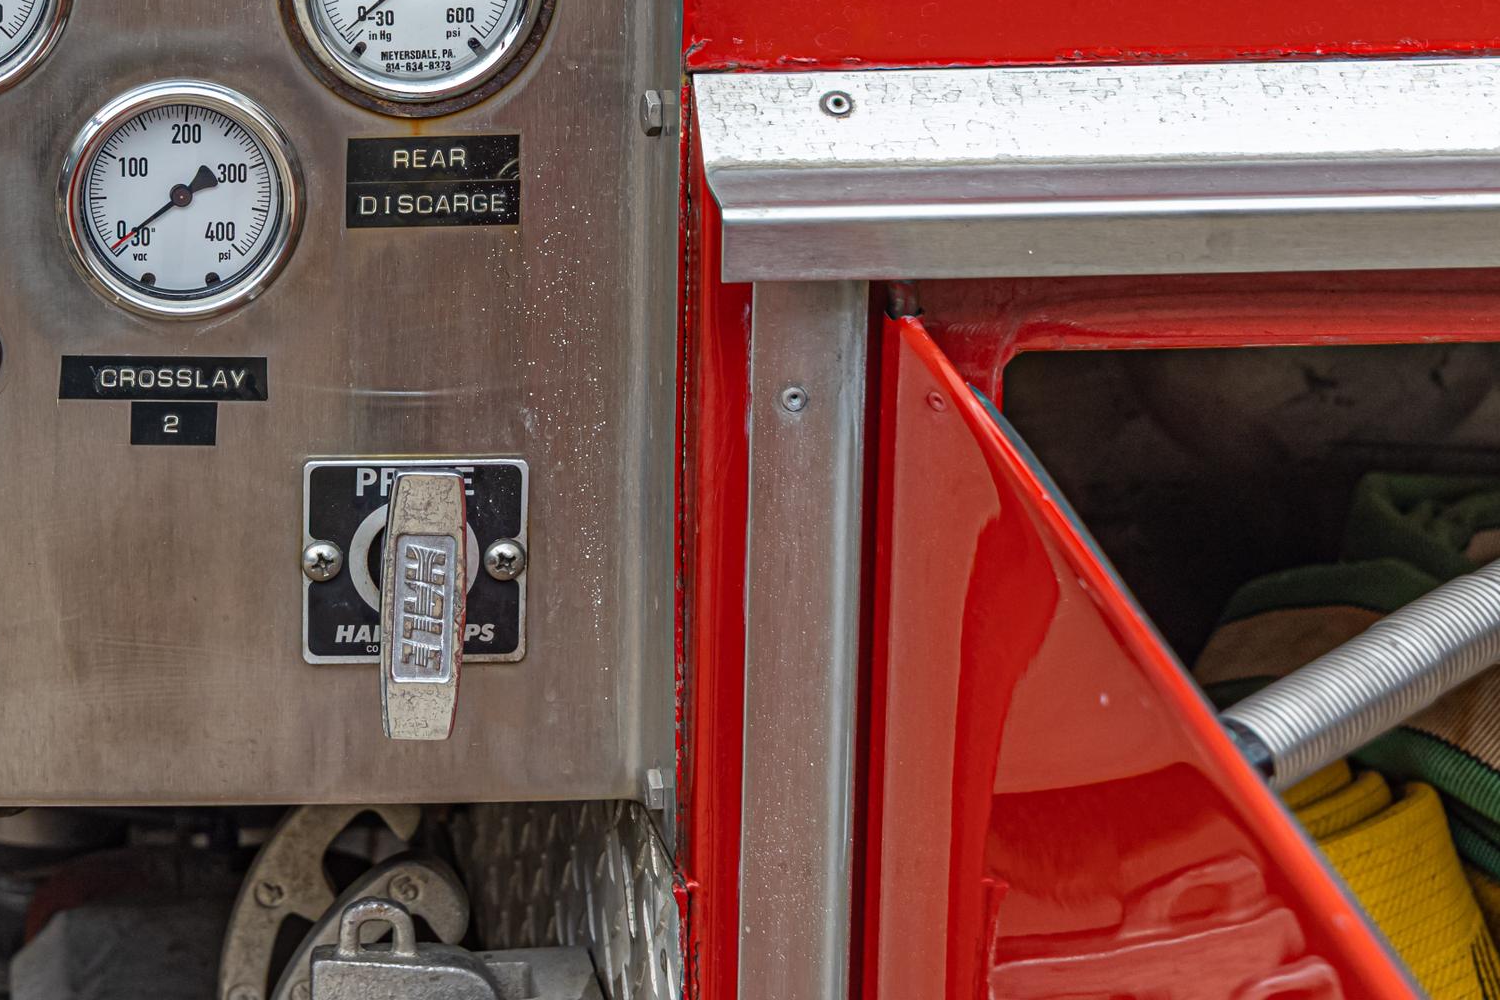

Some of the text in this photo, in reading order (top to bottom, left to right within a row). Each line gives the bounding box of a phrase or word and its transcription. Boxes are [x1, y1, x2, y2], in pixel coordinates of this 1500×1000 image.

[446, 7, 474, 23] 600
[369, 30, 391, 42] in Hg
[446, 28, 460, 39] psi
[172, 124, 201, 144] 200
[119, 157, 148, 177] 100
[394, 149, 466, 168] REAR
[218, 163, 247, 183] 300
[360, 194, 506, 215] DISCARGE
[117, 220, 126, 240] 0
[205, 222, 235, 242] 400
[133, 252, 147, 261] vac
[219, 250, 231, 262] psi
[101, 369, 245, 388] CROSSLAY
[164, 415, 179, 433] 2
